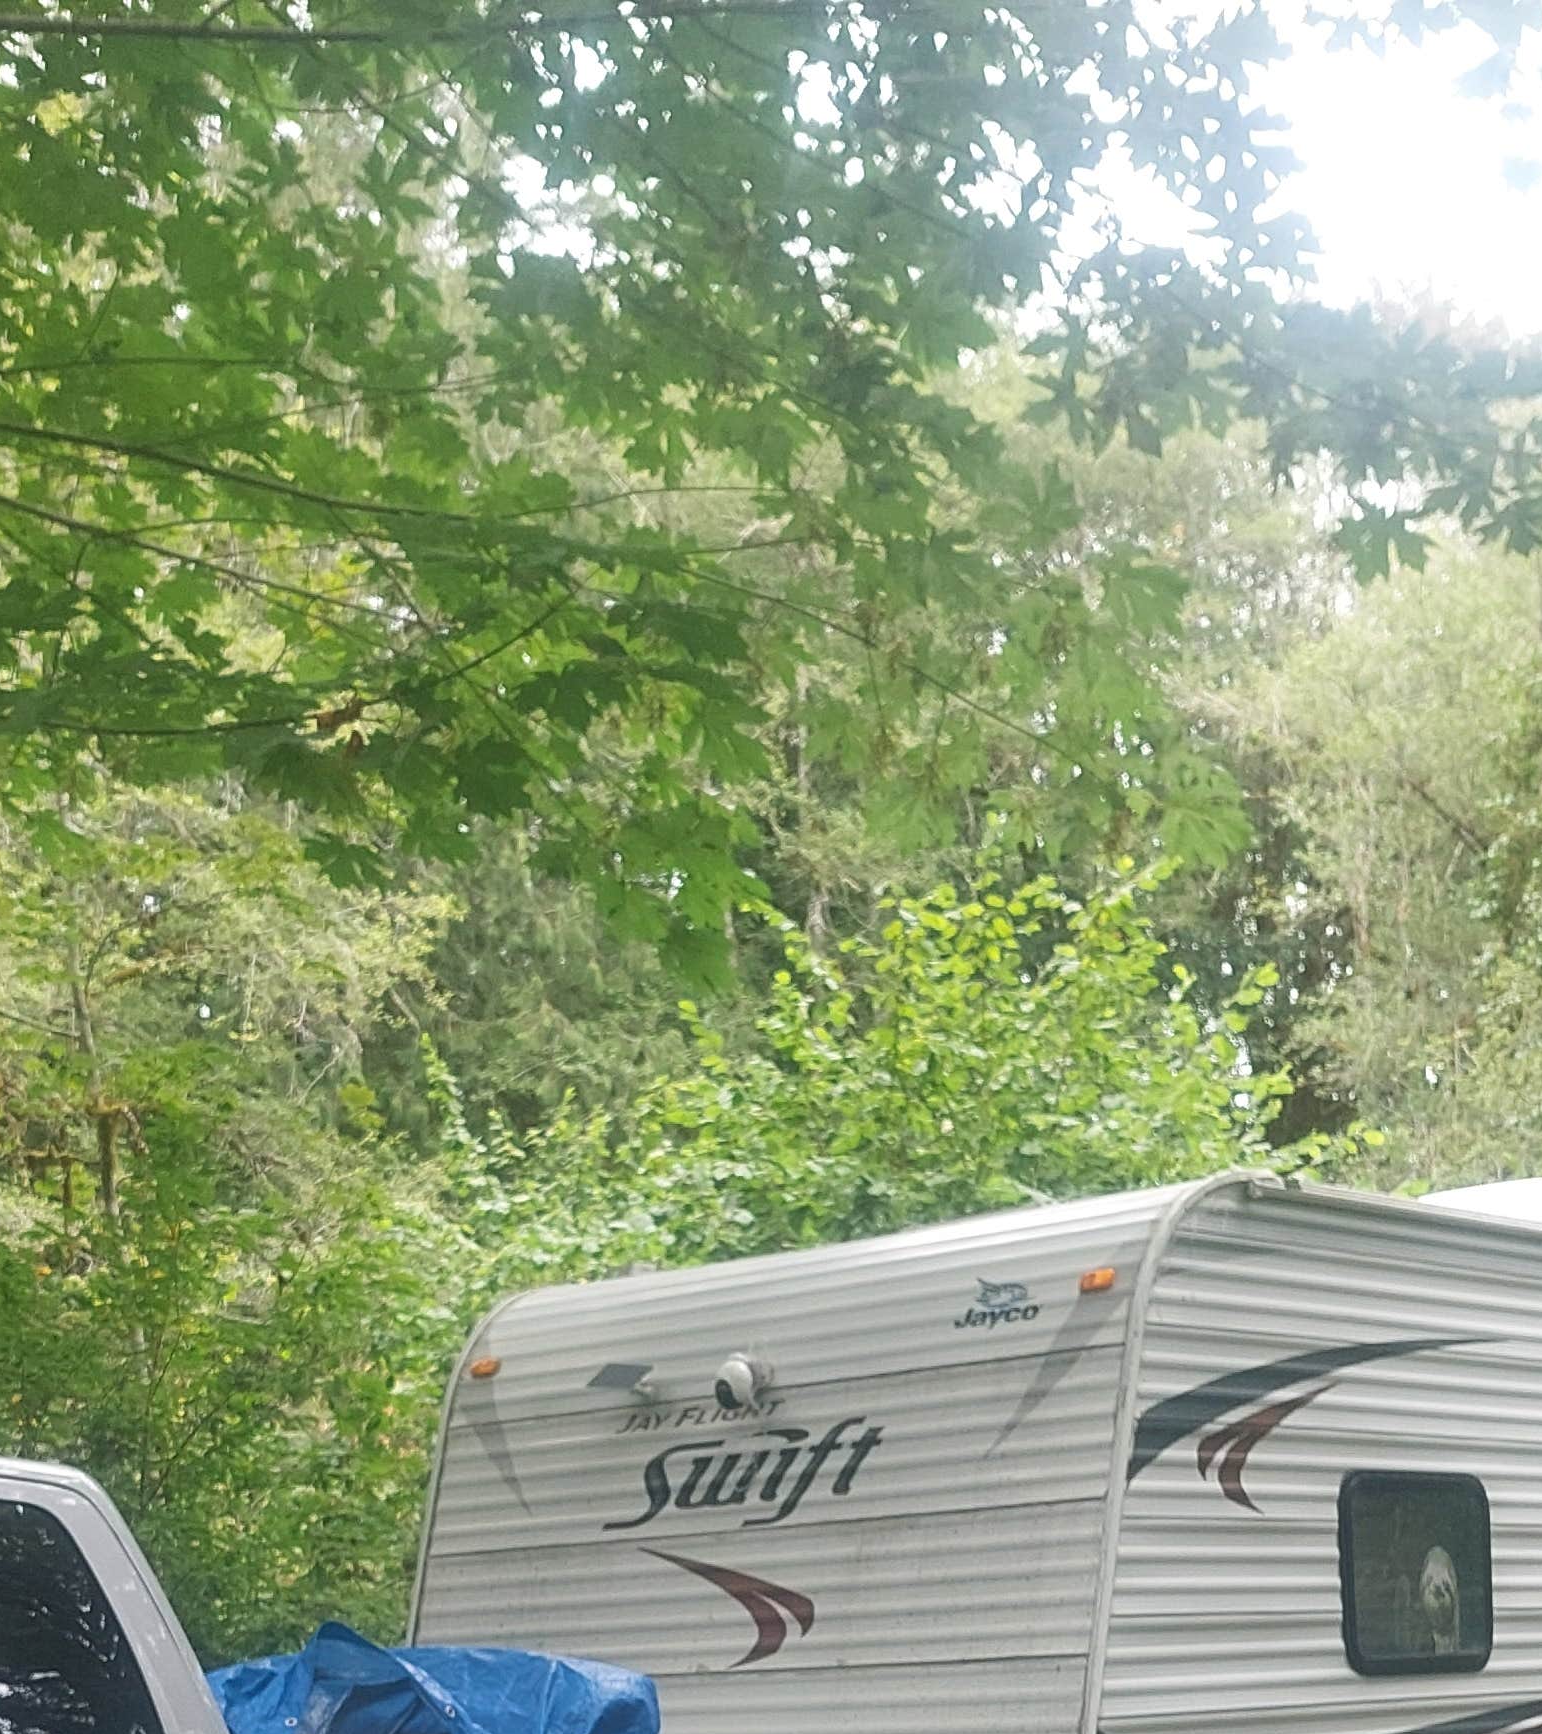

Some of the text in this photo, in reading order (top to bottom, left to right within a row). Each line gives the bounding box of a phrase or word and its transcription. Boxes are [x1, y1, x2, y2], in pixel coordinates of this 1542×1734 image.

[954, 1303, 1040, 1329] Jayco
[616, 1411, 672, 1434] JAY
[602, 1416, 885, 1532] Swift
